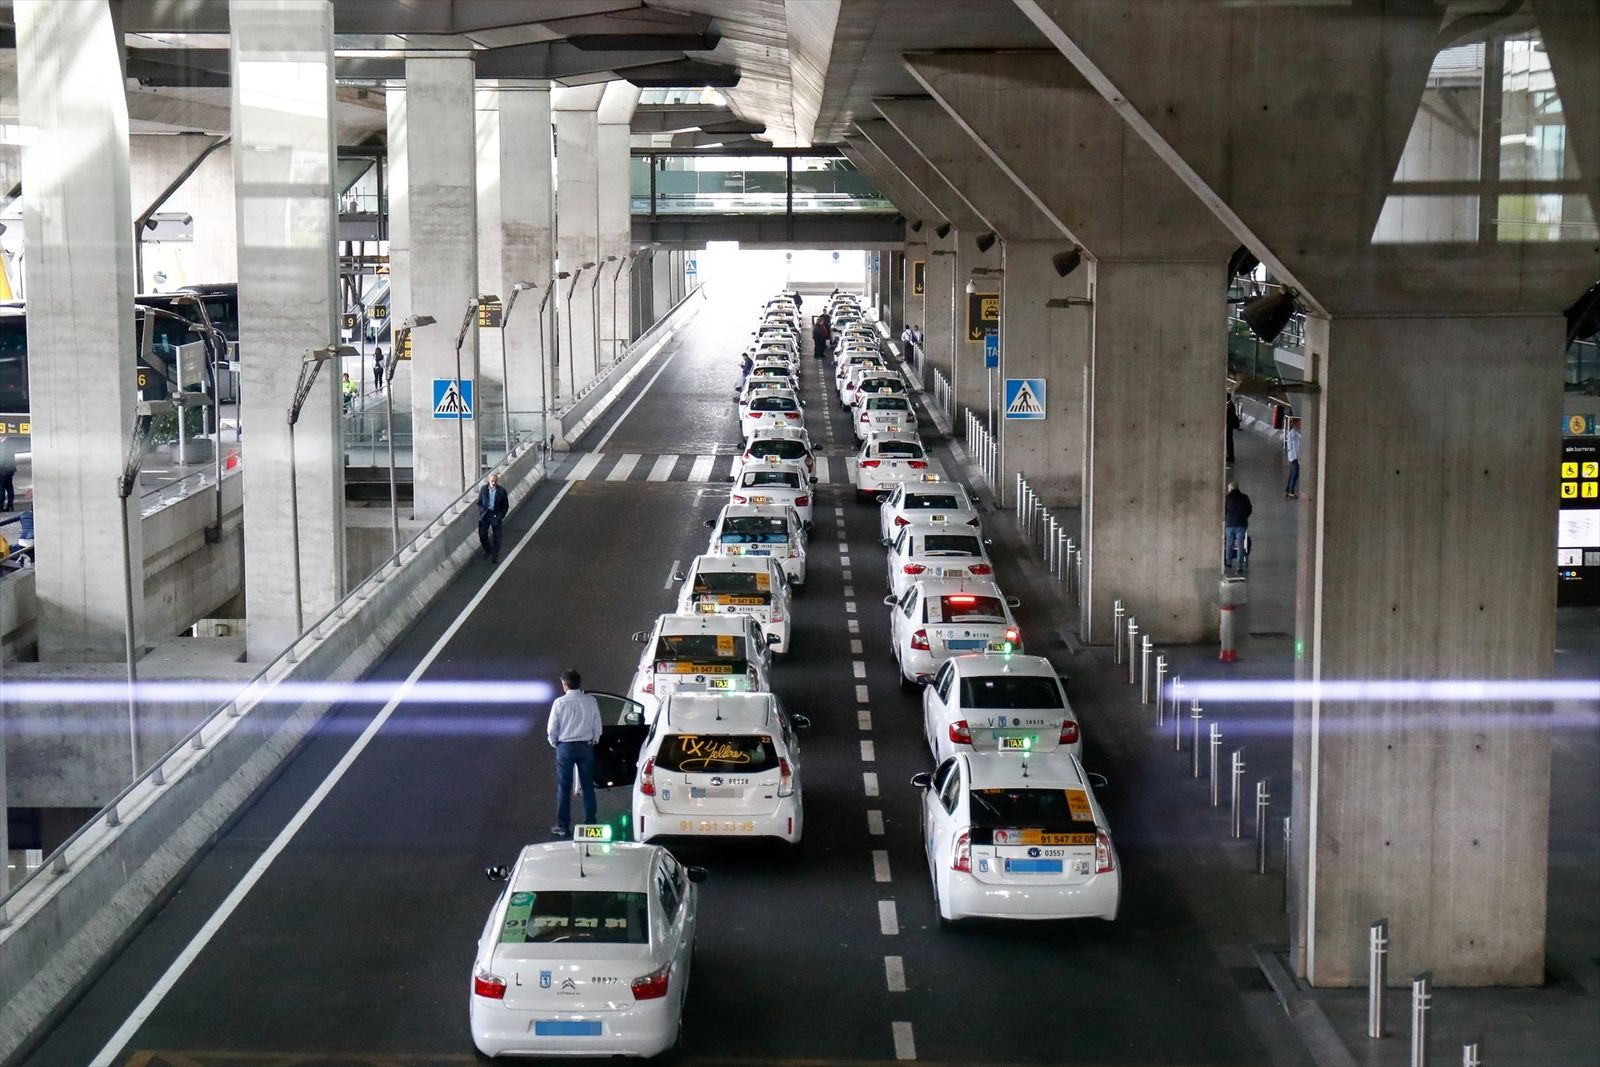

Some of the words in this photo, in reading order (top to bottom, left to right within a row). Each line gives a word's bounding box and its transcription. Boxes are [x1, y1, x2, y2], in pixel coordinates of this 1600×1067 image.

[376, 308, 385, 317] 10
[347, 318, 354, 326] 9
[138, 374, 146, 387] 6
[988, 718, 994, 727] V
[685, 774, 692, 784] L
[1054, 835, 1069, 843] 547
[1072, 835, 1082, 843] 82
[1085, 835, 1095, 843] 00
[995, 847, 1001, 858] L
[506, 920, 526, 928] 91
[516, 973, 522, 986] L
